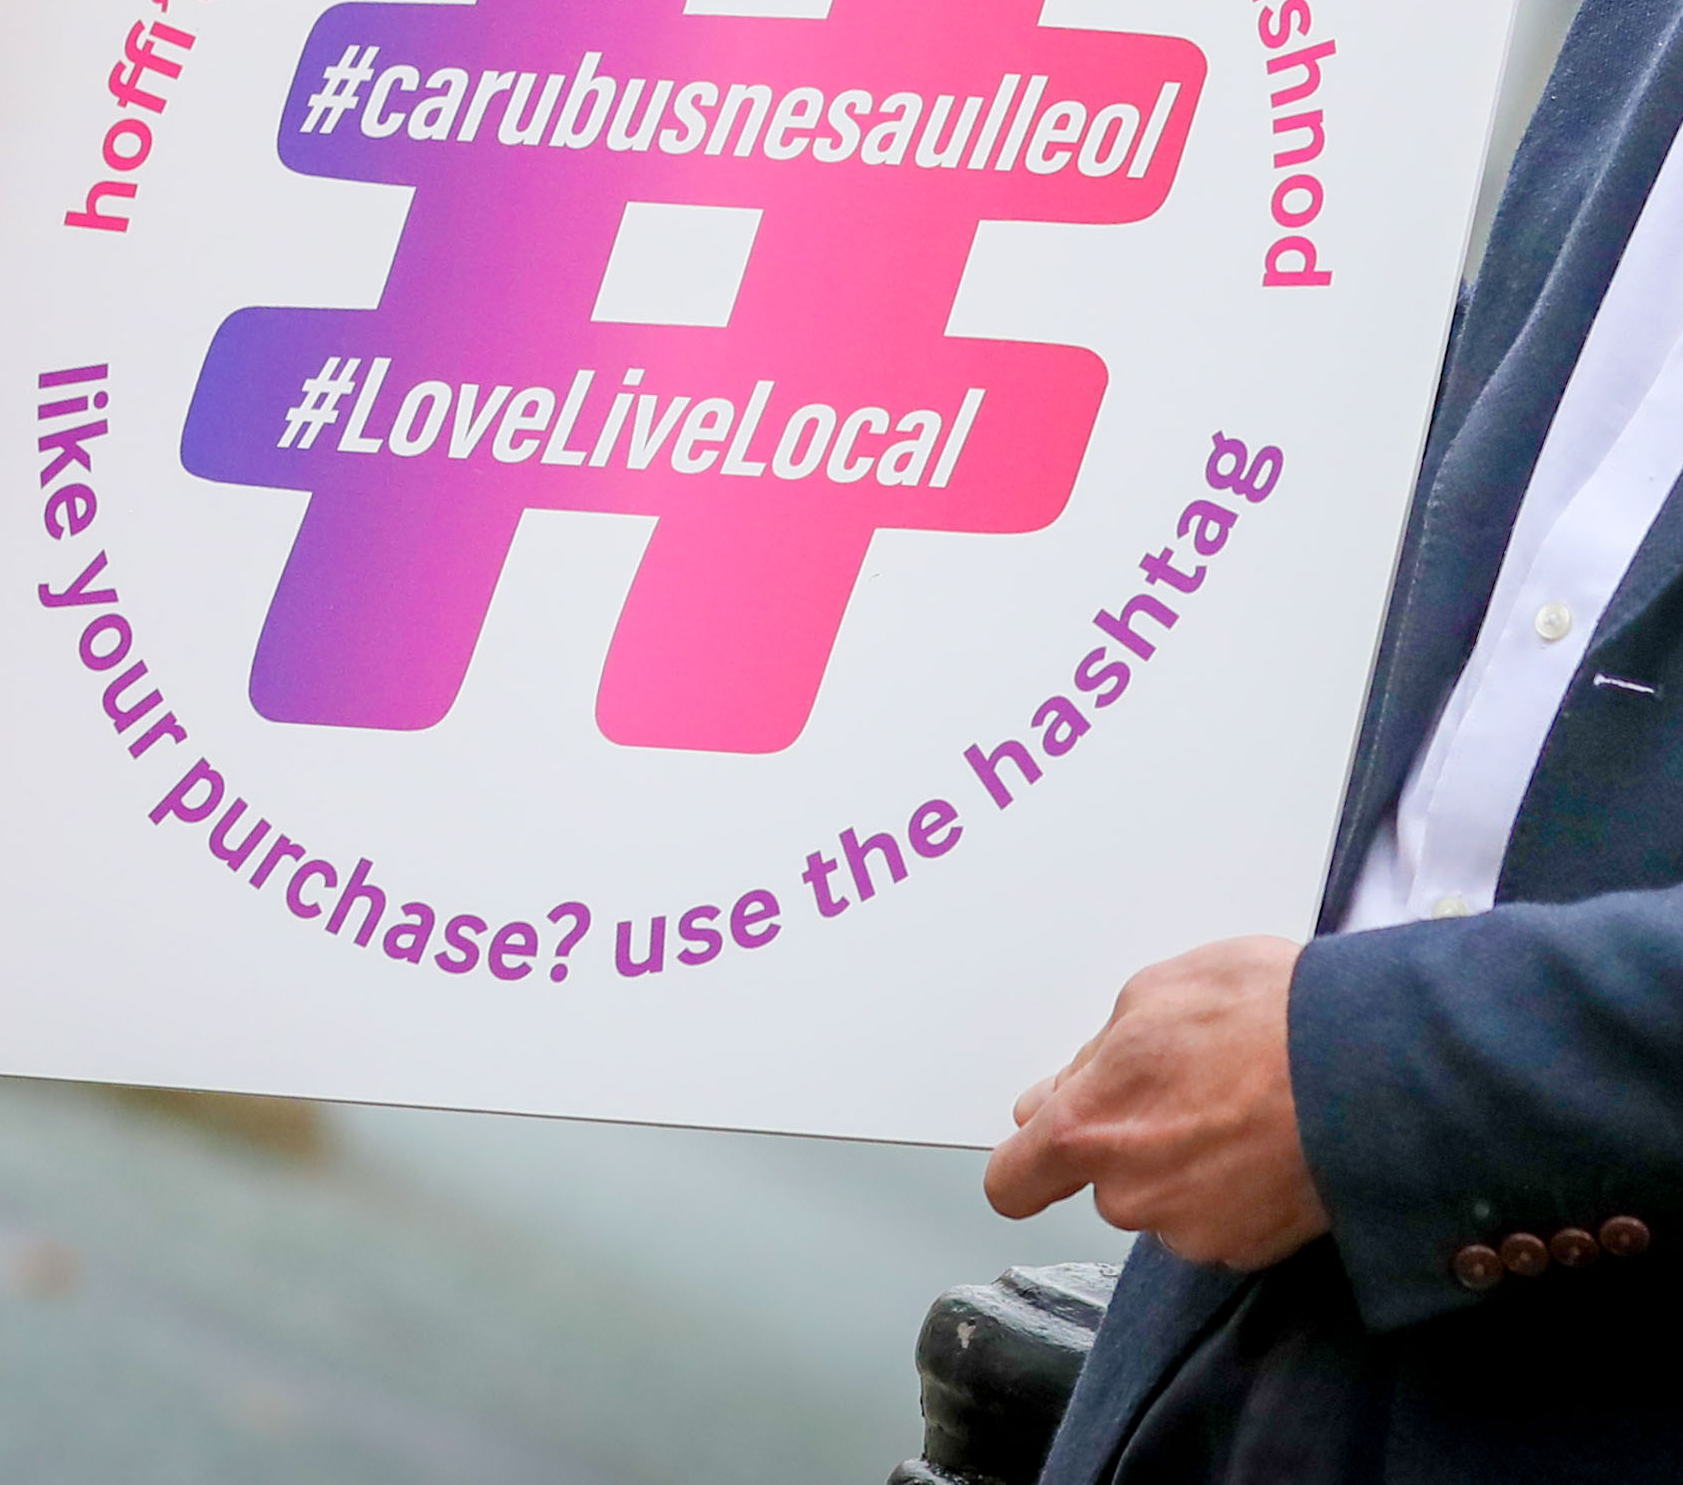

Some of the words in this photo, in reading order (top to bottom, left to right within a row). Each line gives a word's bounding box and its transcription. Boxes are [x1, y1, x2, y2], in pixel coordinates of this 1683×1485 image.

[299, 44, 1181, 179] #carubusnesaulleol
[38, 364, 108, 539] like
[279, 356, 986, 489] #LoveLiveLocal
[39, 552, 186, 758] your
[965, 432, 1283, 808] hashtag
[150, 759, 590, 982] purchase?
[616, 890, 780, 977] use
[803, 800, 962, 917] the
